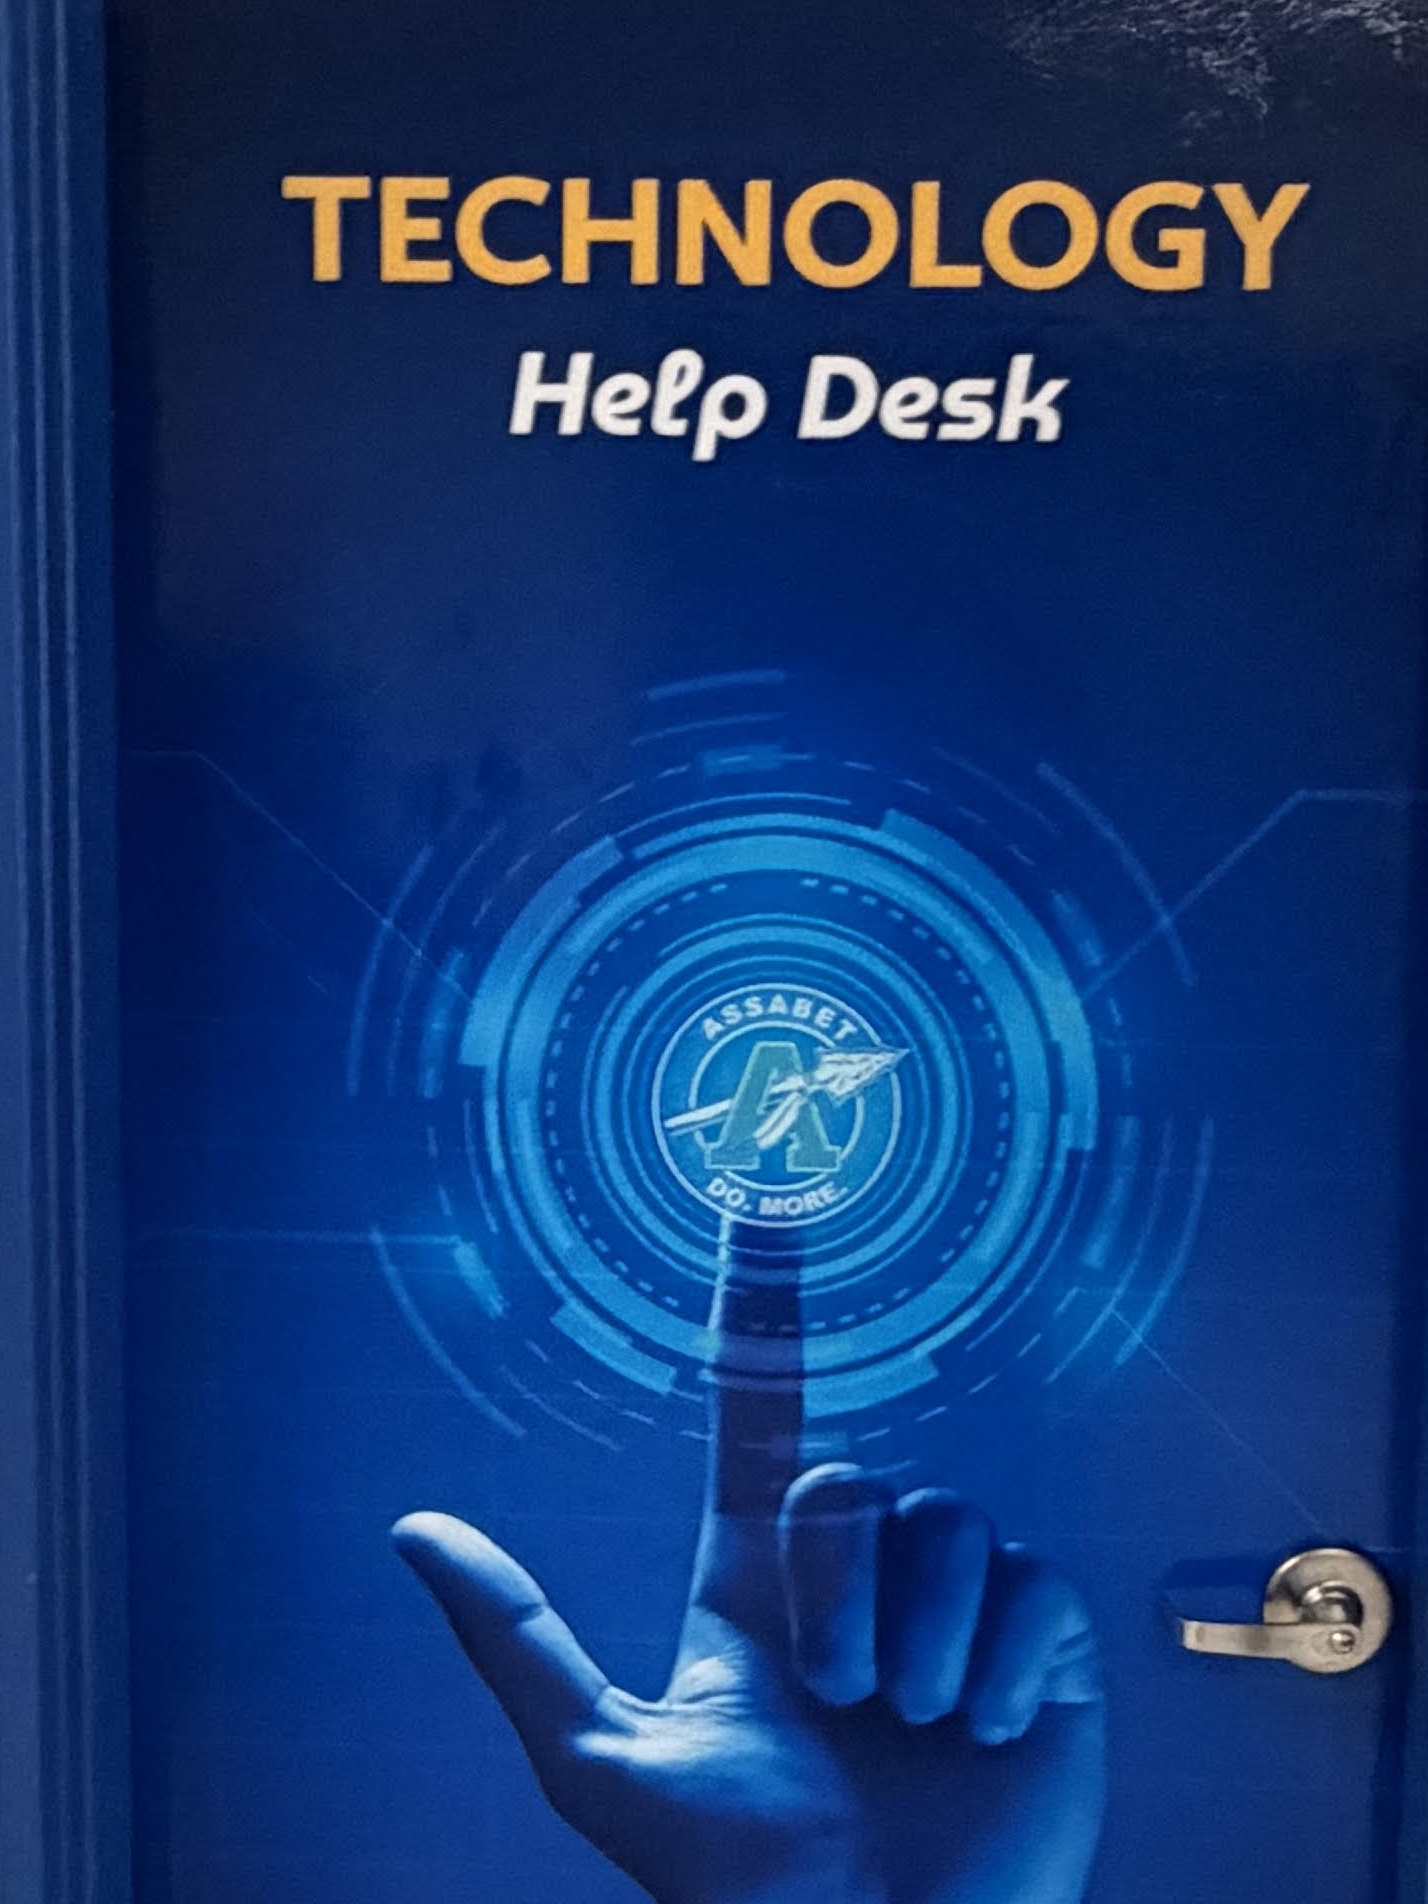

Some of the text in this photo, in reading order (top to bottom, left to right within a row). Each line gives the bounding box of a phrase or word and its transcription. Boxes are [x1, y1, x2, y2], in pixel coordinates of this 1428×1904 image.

[281, 175, 1309, 293] TECHNOLOGY
[508, 348, 1071, 462] Help Desk
[702, 994, 858, 1041] ASSABET
[706, 1177, 849, 1216] DO. MORE.
